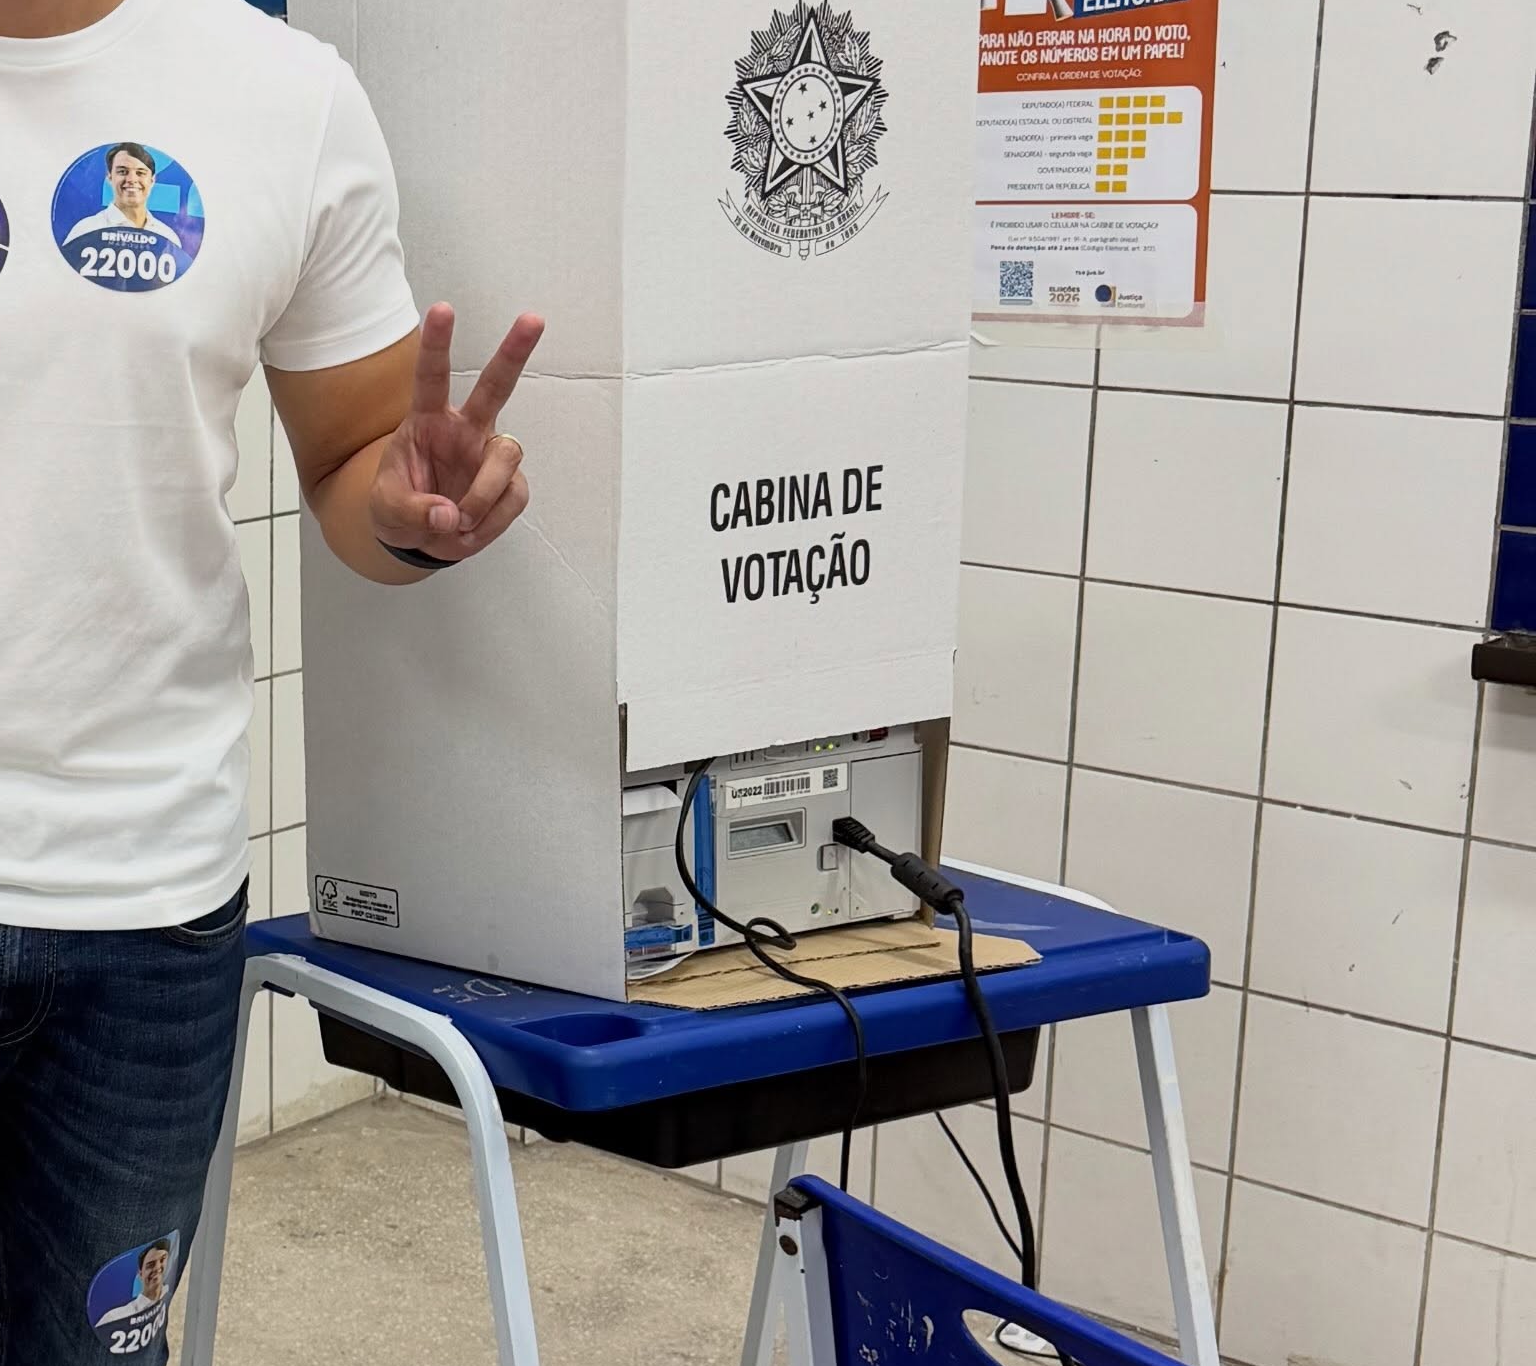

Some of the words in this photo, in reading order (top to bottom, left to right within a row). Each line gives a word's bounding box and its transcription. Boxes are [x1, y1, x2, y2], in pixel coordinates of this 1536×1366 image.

[979, 33, 1006, 49] PARA
[1007, 30, 1033, 47] NÃO
[1036, 30, 1074, 47] ERRAR
[1078, 28, 1094, 44] NA
[1098, 26, 1131, 43] HORA
[1134, 25, 1152, 42] DO
[1154, 24, 1191, 41] VOTO,
[980, 49, 1018, 67] ANOTE
[1021, 49, 1037, 65] OS
[1040, 46, 1098, 64] NÚMEROS
[1101, 45, 1119, 61] EM
[1121, 44, 1141, 60] UM
[1144, 42, 1185, 60] PAPEL!
[1016, 71, 1051, 82] CONFIRA
[1052, 71, 1059, 81] A
[1060, 70, 1089, 81] ORDEM
[1089, 70, 1100, 80] DE
[1007, 182, 1044, 191] PRESIDENTE
[80, 246, 177, 283] 22000
[1049, 293, 1081, 303] 2026
[1118, 293, 1143, 301] Justiça
[710, 471, 833, 532] CABINA
[842, 464, 883, 515] DE
[721, 531, 871, 605] VOTAÇÃO
